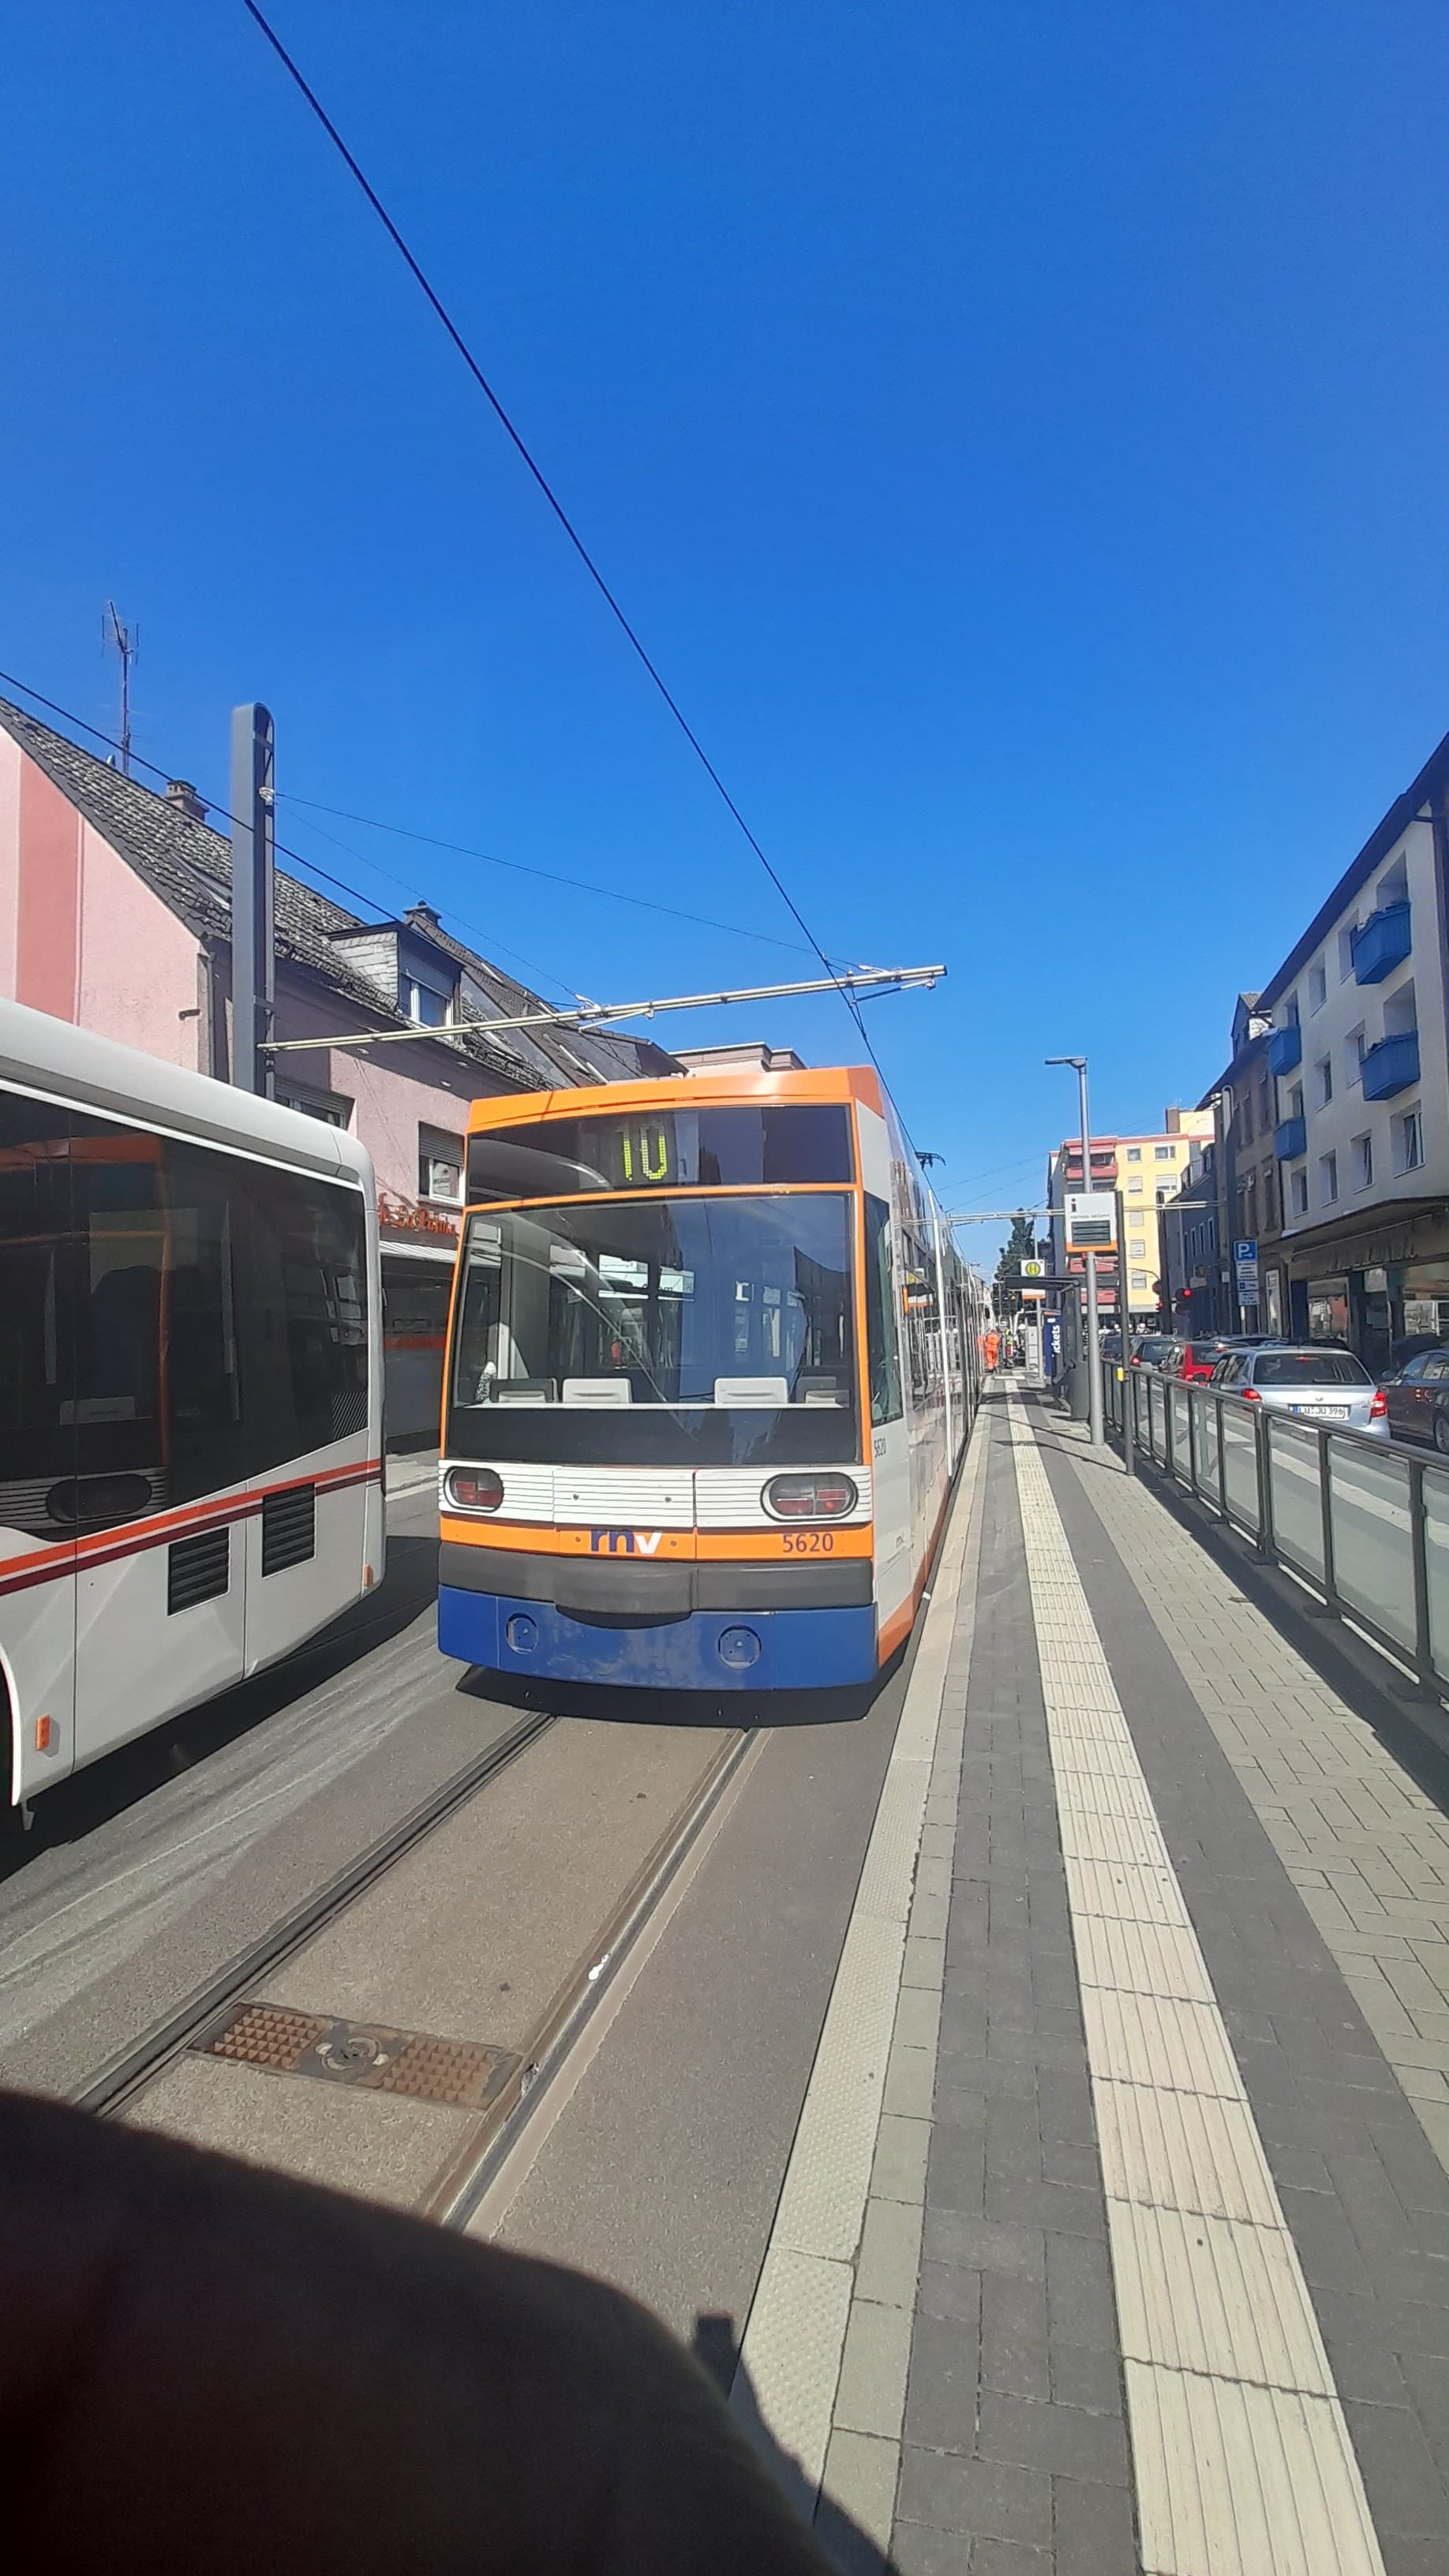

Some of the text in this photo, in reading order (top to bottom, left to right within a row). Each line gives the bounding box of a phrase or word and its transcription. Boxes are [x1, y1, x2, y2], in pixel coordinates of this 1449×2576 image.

[615, 1121, 668, 1181] 10
[1237, 1243, 1250, 1259] P
[1050, 1324, 1061, 1357] ickets
[782, 1533, 834, 1553] 5620
